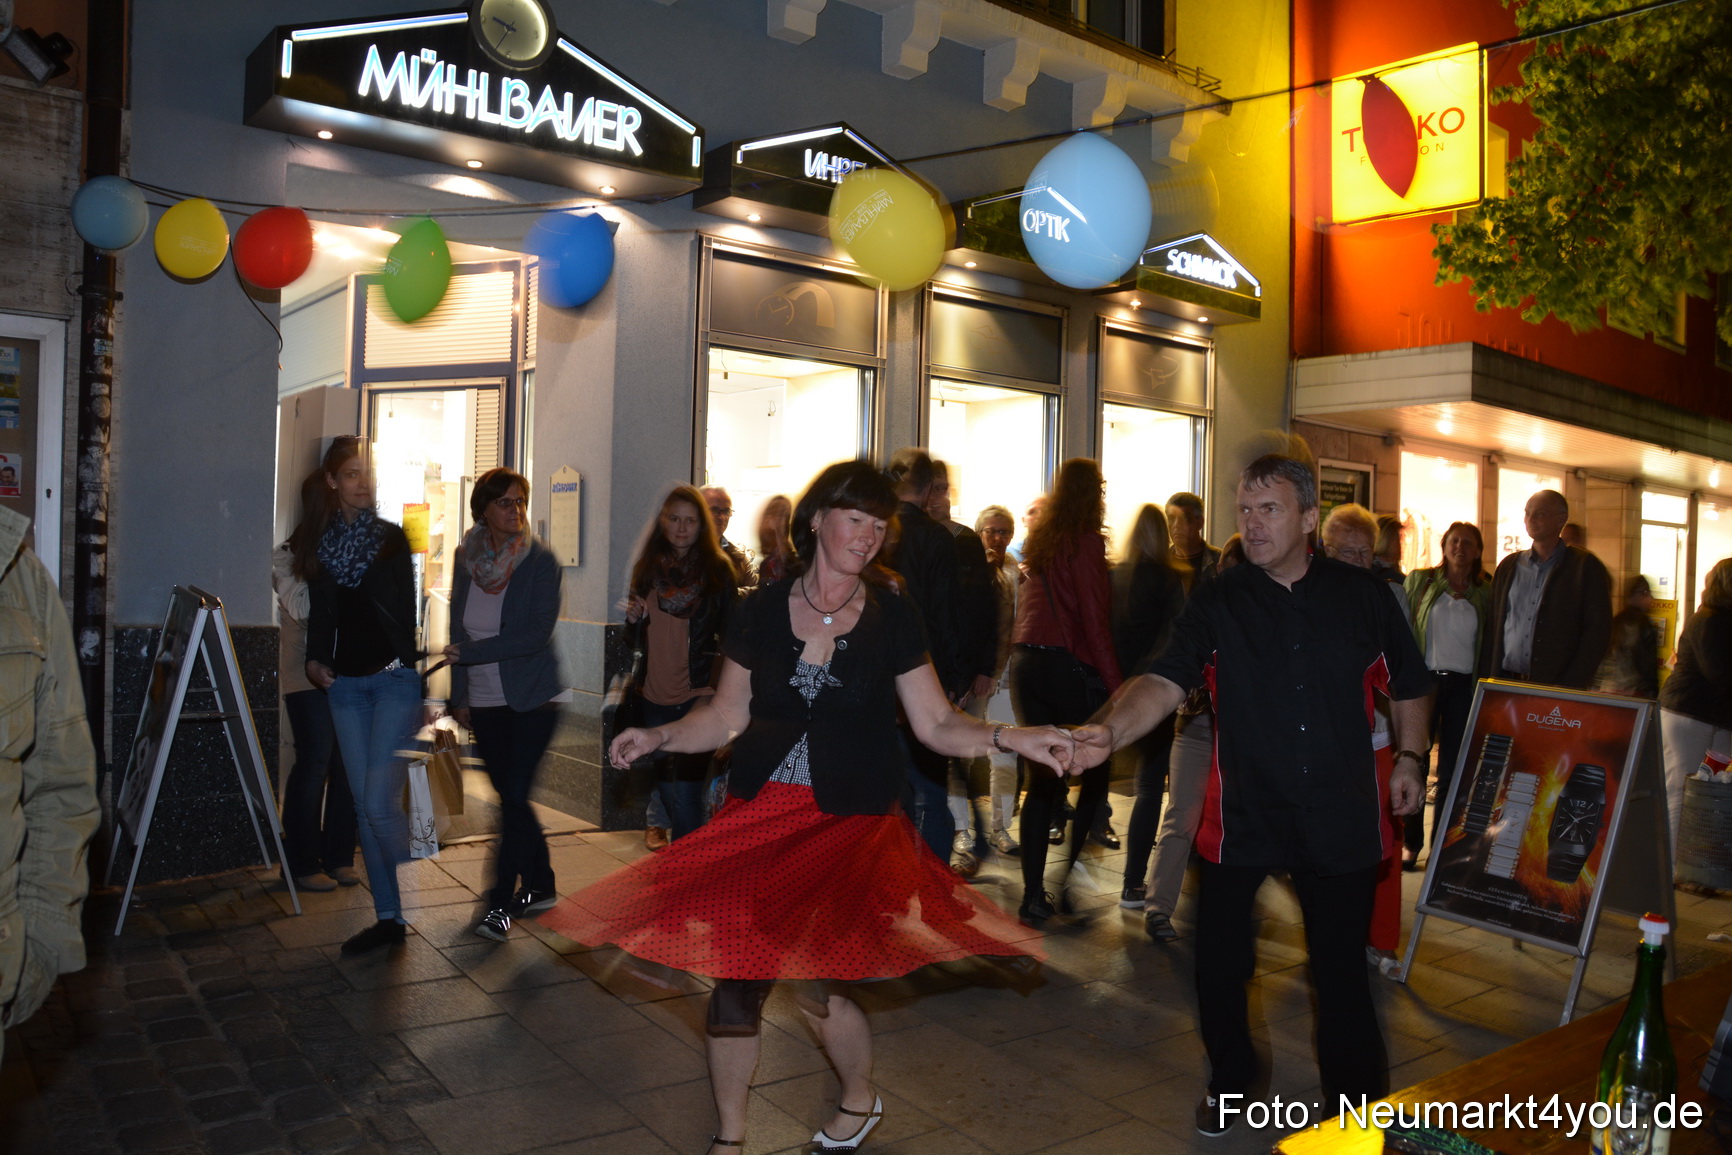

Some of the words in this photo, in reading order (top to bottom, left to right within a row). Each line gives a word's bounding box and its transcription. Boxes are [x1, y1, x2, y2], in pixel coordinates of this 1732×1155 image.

[358, 43, 643, 157] MÜHLBAUER
[1341, 106, 1466, 153] TKO
[804, 148, 870, 185] UHR
[1022, 208, 1070, 243] OPTIK
[1526, 712, 1582, 729] DUGENA
